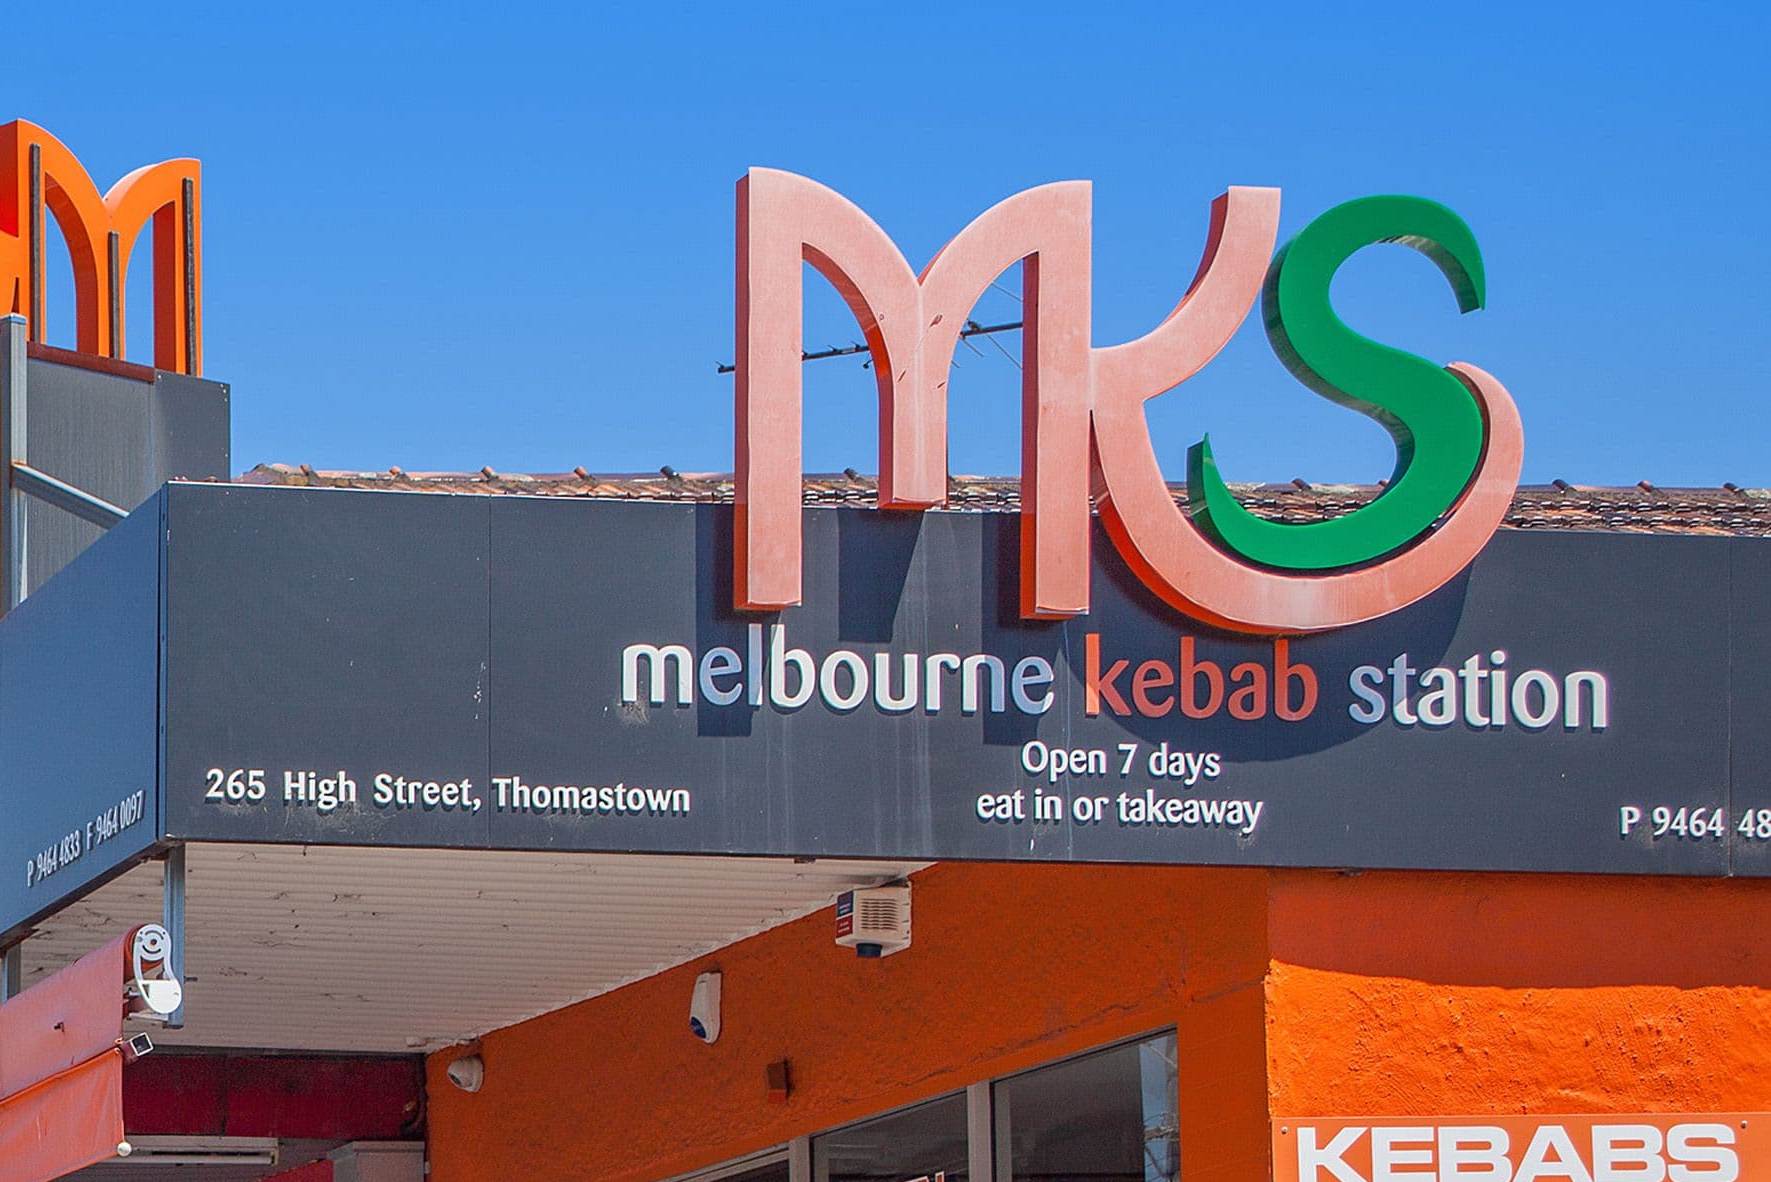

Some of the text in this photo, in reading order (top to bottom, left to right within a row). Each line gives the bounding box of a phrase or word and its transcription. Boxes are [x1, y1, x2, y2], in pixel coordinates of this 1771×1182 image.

[734, 166, 1524, 635] MKS
[621, 623, 1609, 728] melbourne kebab station
[1021, 740, 1221, 786] Open 7 days
[206, 768, 691, 814] 265 High Street, Thomastown
[977, 790, 1263, 835] eat in or takeaway
[27, 789, 144, 888] P 9464 4833 F 9464 0097
[1619, 805, 1641, 836] P
[1651, 805, 1726, 838] 9464
